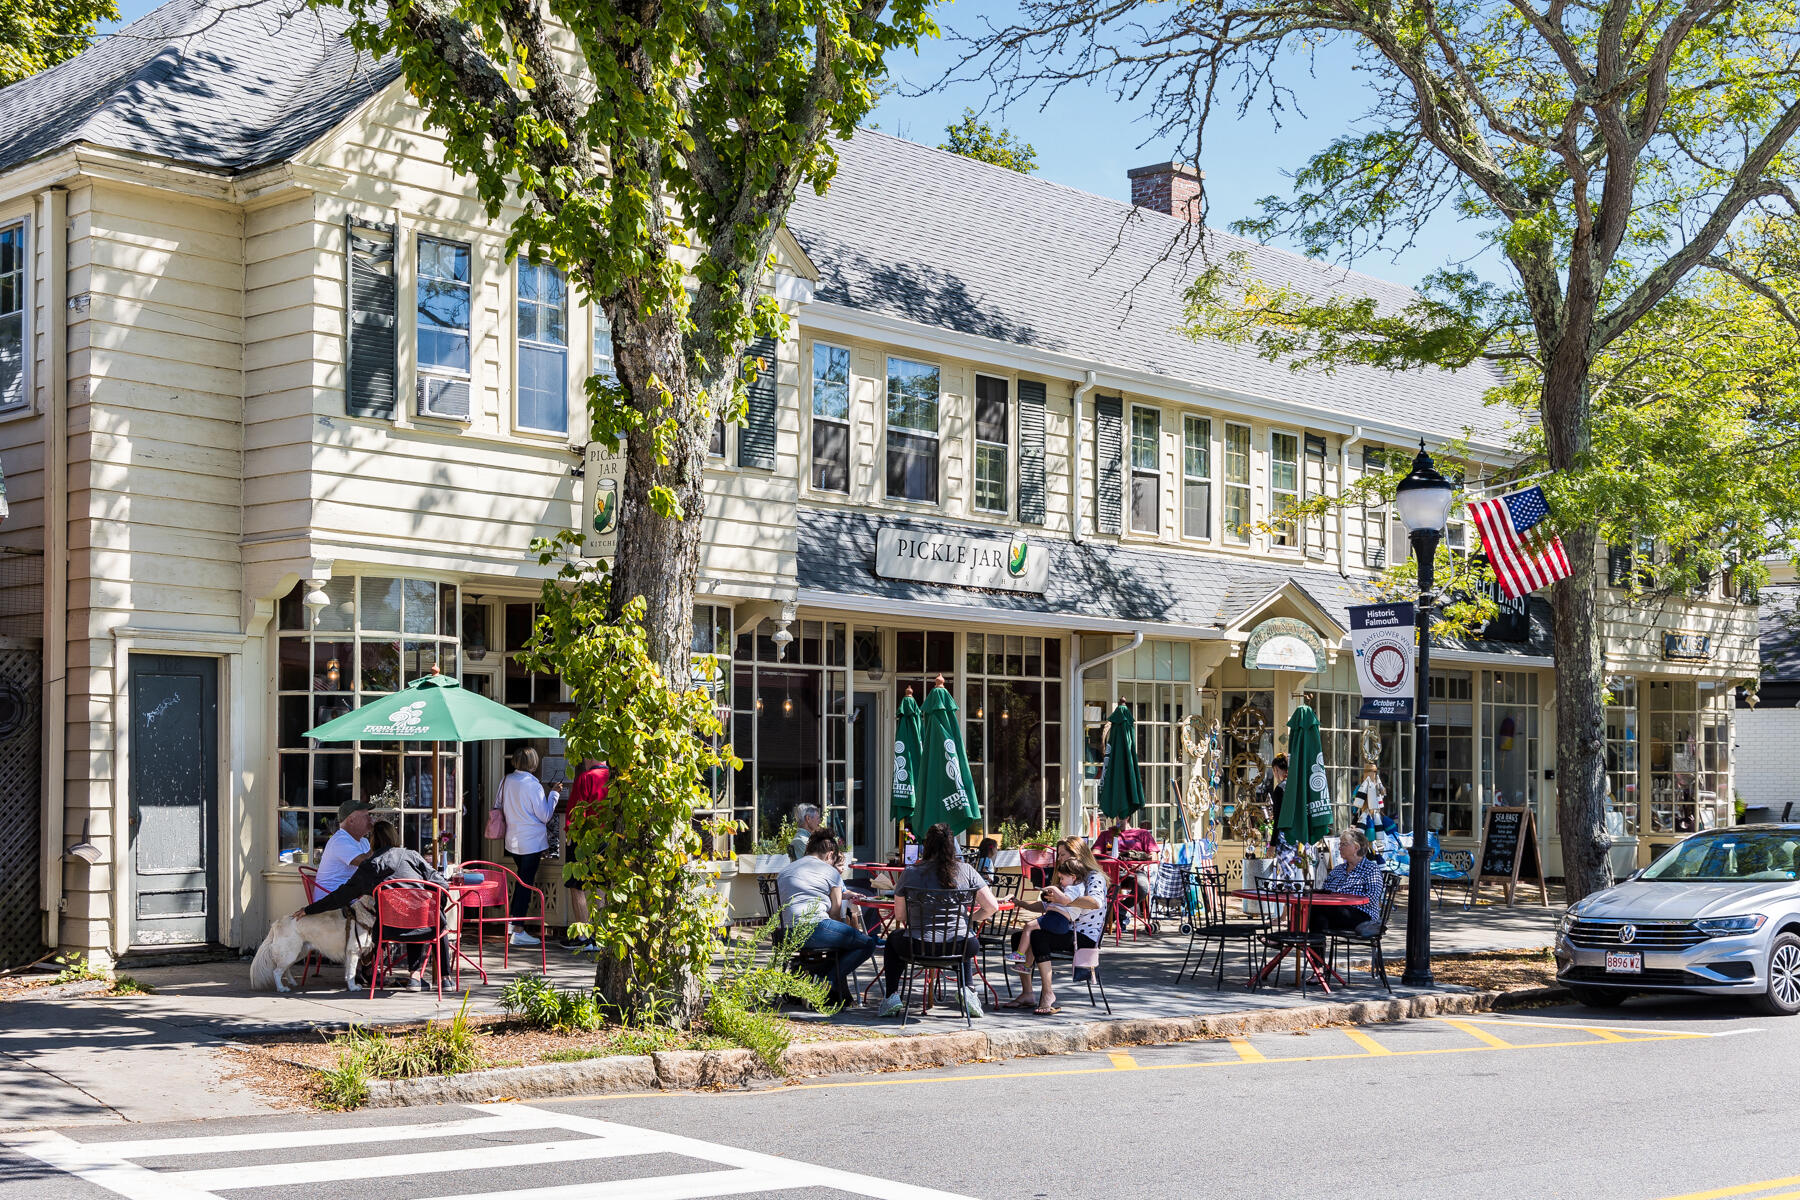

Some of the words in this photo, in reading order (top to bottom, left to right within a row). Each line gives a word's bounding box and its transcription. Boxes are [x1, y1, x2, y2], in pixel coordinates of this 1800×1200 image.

[598, 463, 618, 477] JAR
[590, 540, 616, 548] KITCHE
[897, 538, 967, 564] PICKLE
[970, 547, 1003, 570] JAR
[952, 574, 1030, 587] KITCHEN
[1367, 608, 1395, 618] Historic
[1365, 617, 1399, 626] Falmouth
[1361, 630, 1399, 649] MAYFLOWER
[1400, 635, 1413, 655] WIND
[1372, 699, 1396, 707] October
[1396, 699, 1405, 707] 1-2
[1494, 813, 1505, 823] SEA
[1505, 813, 1519, 823] BAGS
[1607, 956, 1628, 968] 8896
